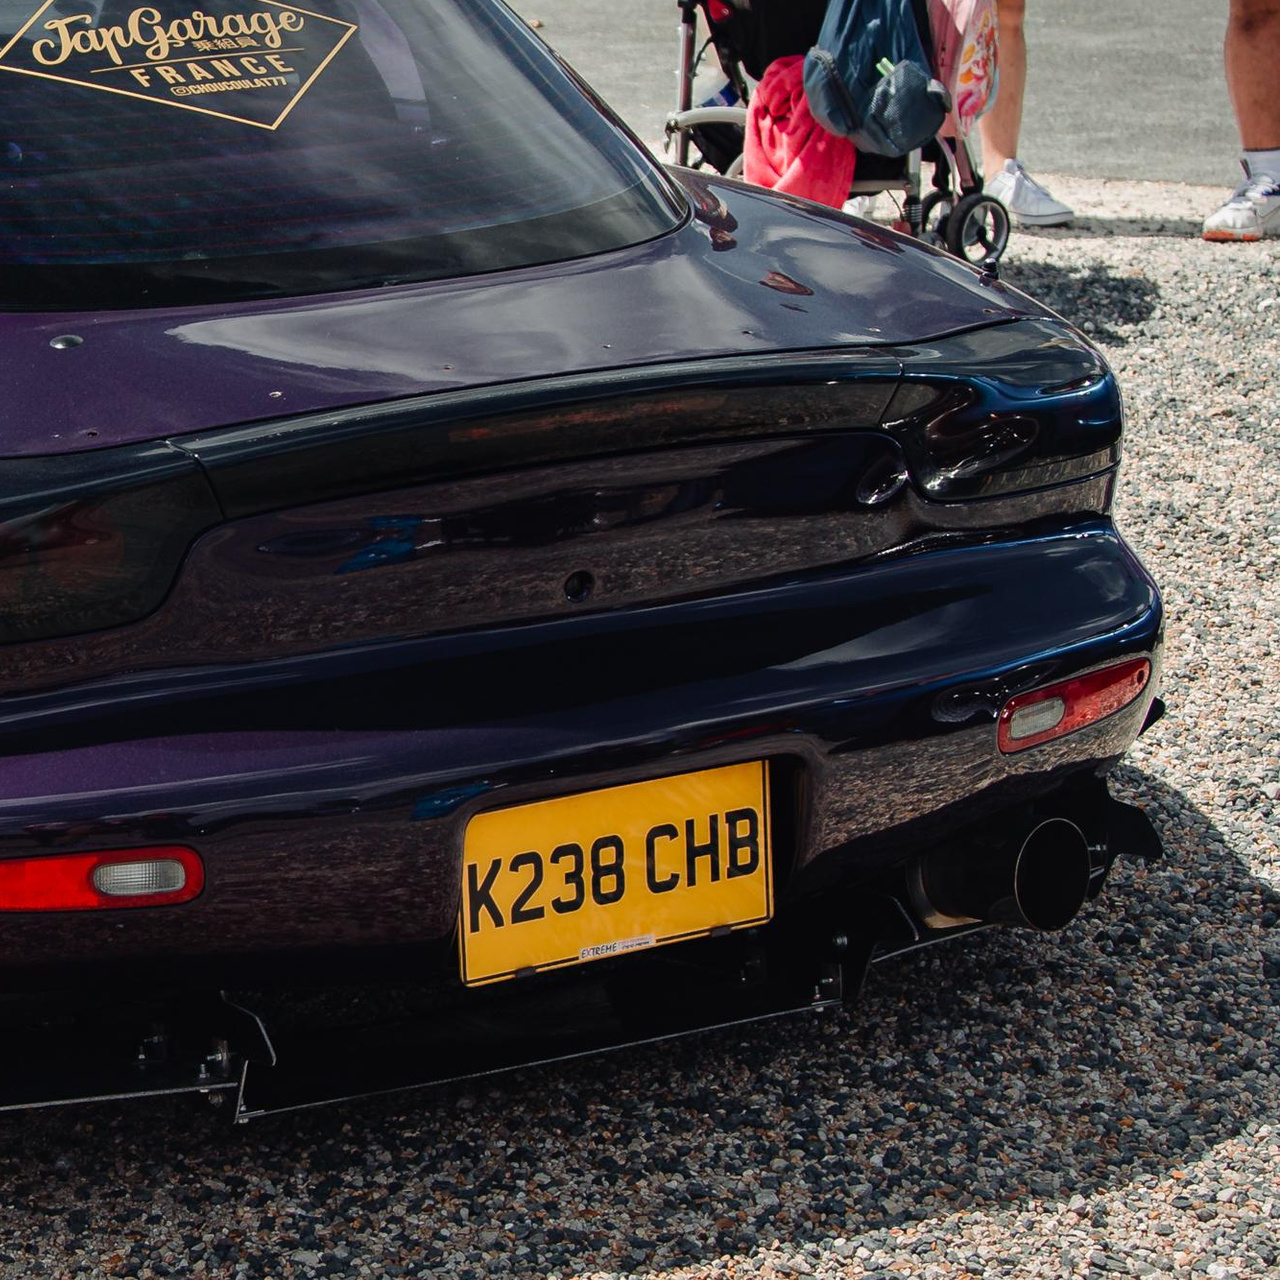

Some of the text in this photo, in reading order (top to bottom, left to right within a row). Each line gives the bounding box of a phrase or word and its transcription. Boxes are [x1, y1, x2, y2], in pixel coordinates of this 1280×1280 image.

[130, 54, 295, 88] FRANCE
[467, 807, 760, 934] K238 CHB
[581, 942, 617, 959] EXTREME
